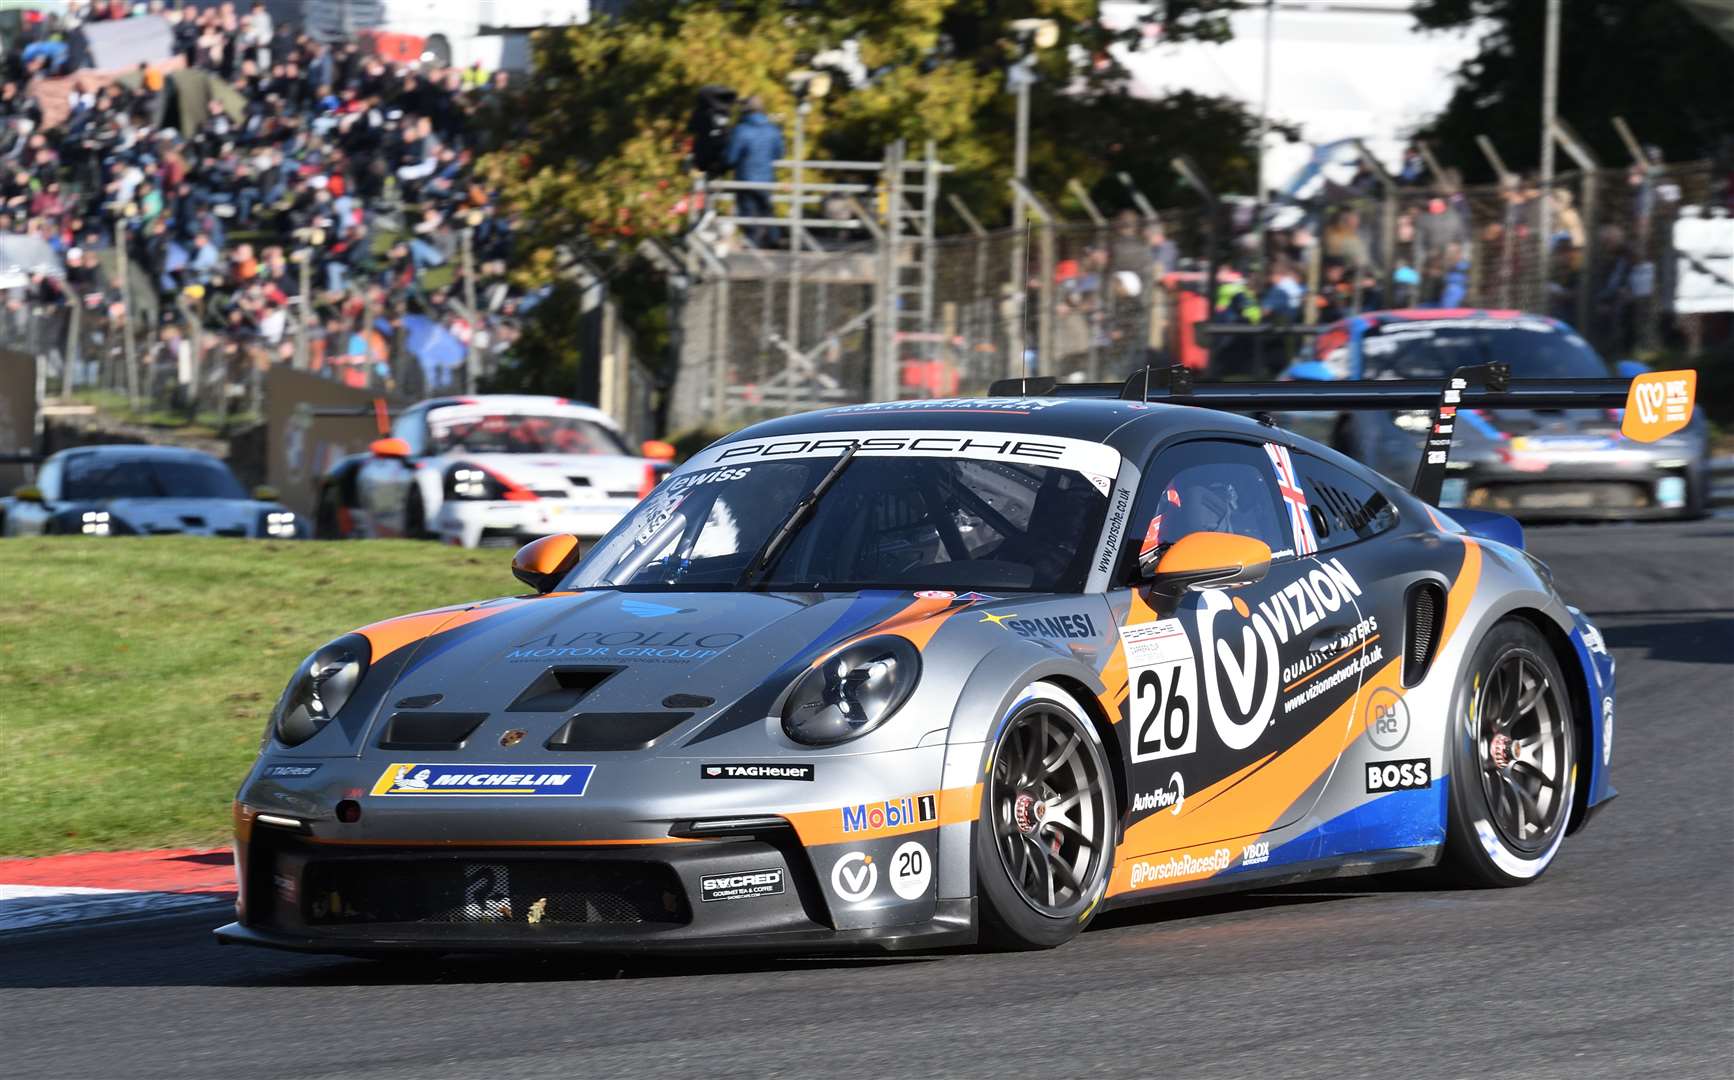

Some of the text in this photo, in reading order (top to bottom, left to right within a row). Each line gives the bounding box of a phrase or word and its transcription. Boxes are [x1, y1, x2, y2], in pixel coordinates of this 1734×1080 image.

[715, 438, 1067, 462] PORSCHE
[1098, 488, 1131, 573] www.porsche.co.uk
[1259, 557, 1362, 644] VIZION
[511, 631, 745, 648] APOLLO
[1008, 613, 1096, 639] SPANESI
[505, 647, 718, 658] MOTOR GROUP
[1284, 644, 1384, 714] www.vizionnetwork.co.uk
[1136, 664, 1190, 757] 26
[433, 773, 572, 786] MICHELIN
[1368, 761, 1428, 789] BOSS
[1132, 787, 1177, 812] AutoFlow
[842, 798, 914, 833] Mobil
[899, 850, 922, 877] 20
[1242, 841, 1269, 860] VBOX
[1130, 847, 1230, 888] @PorscheRacesGB
